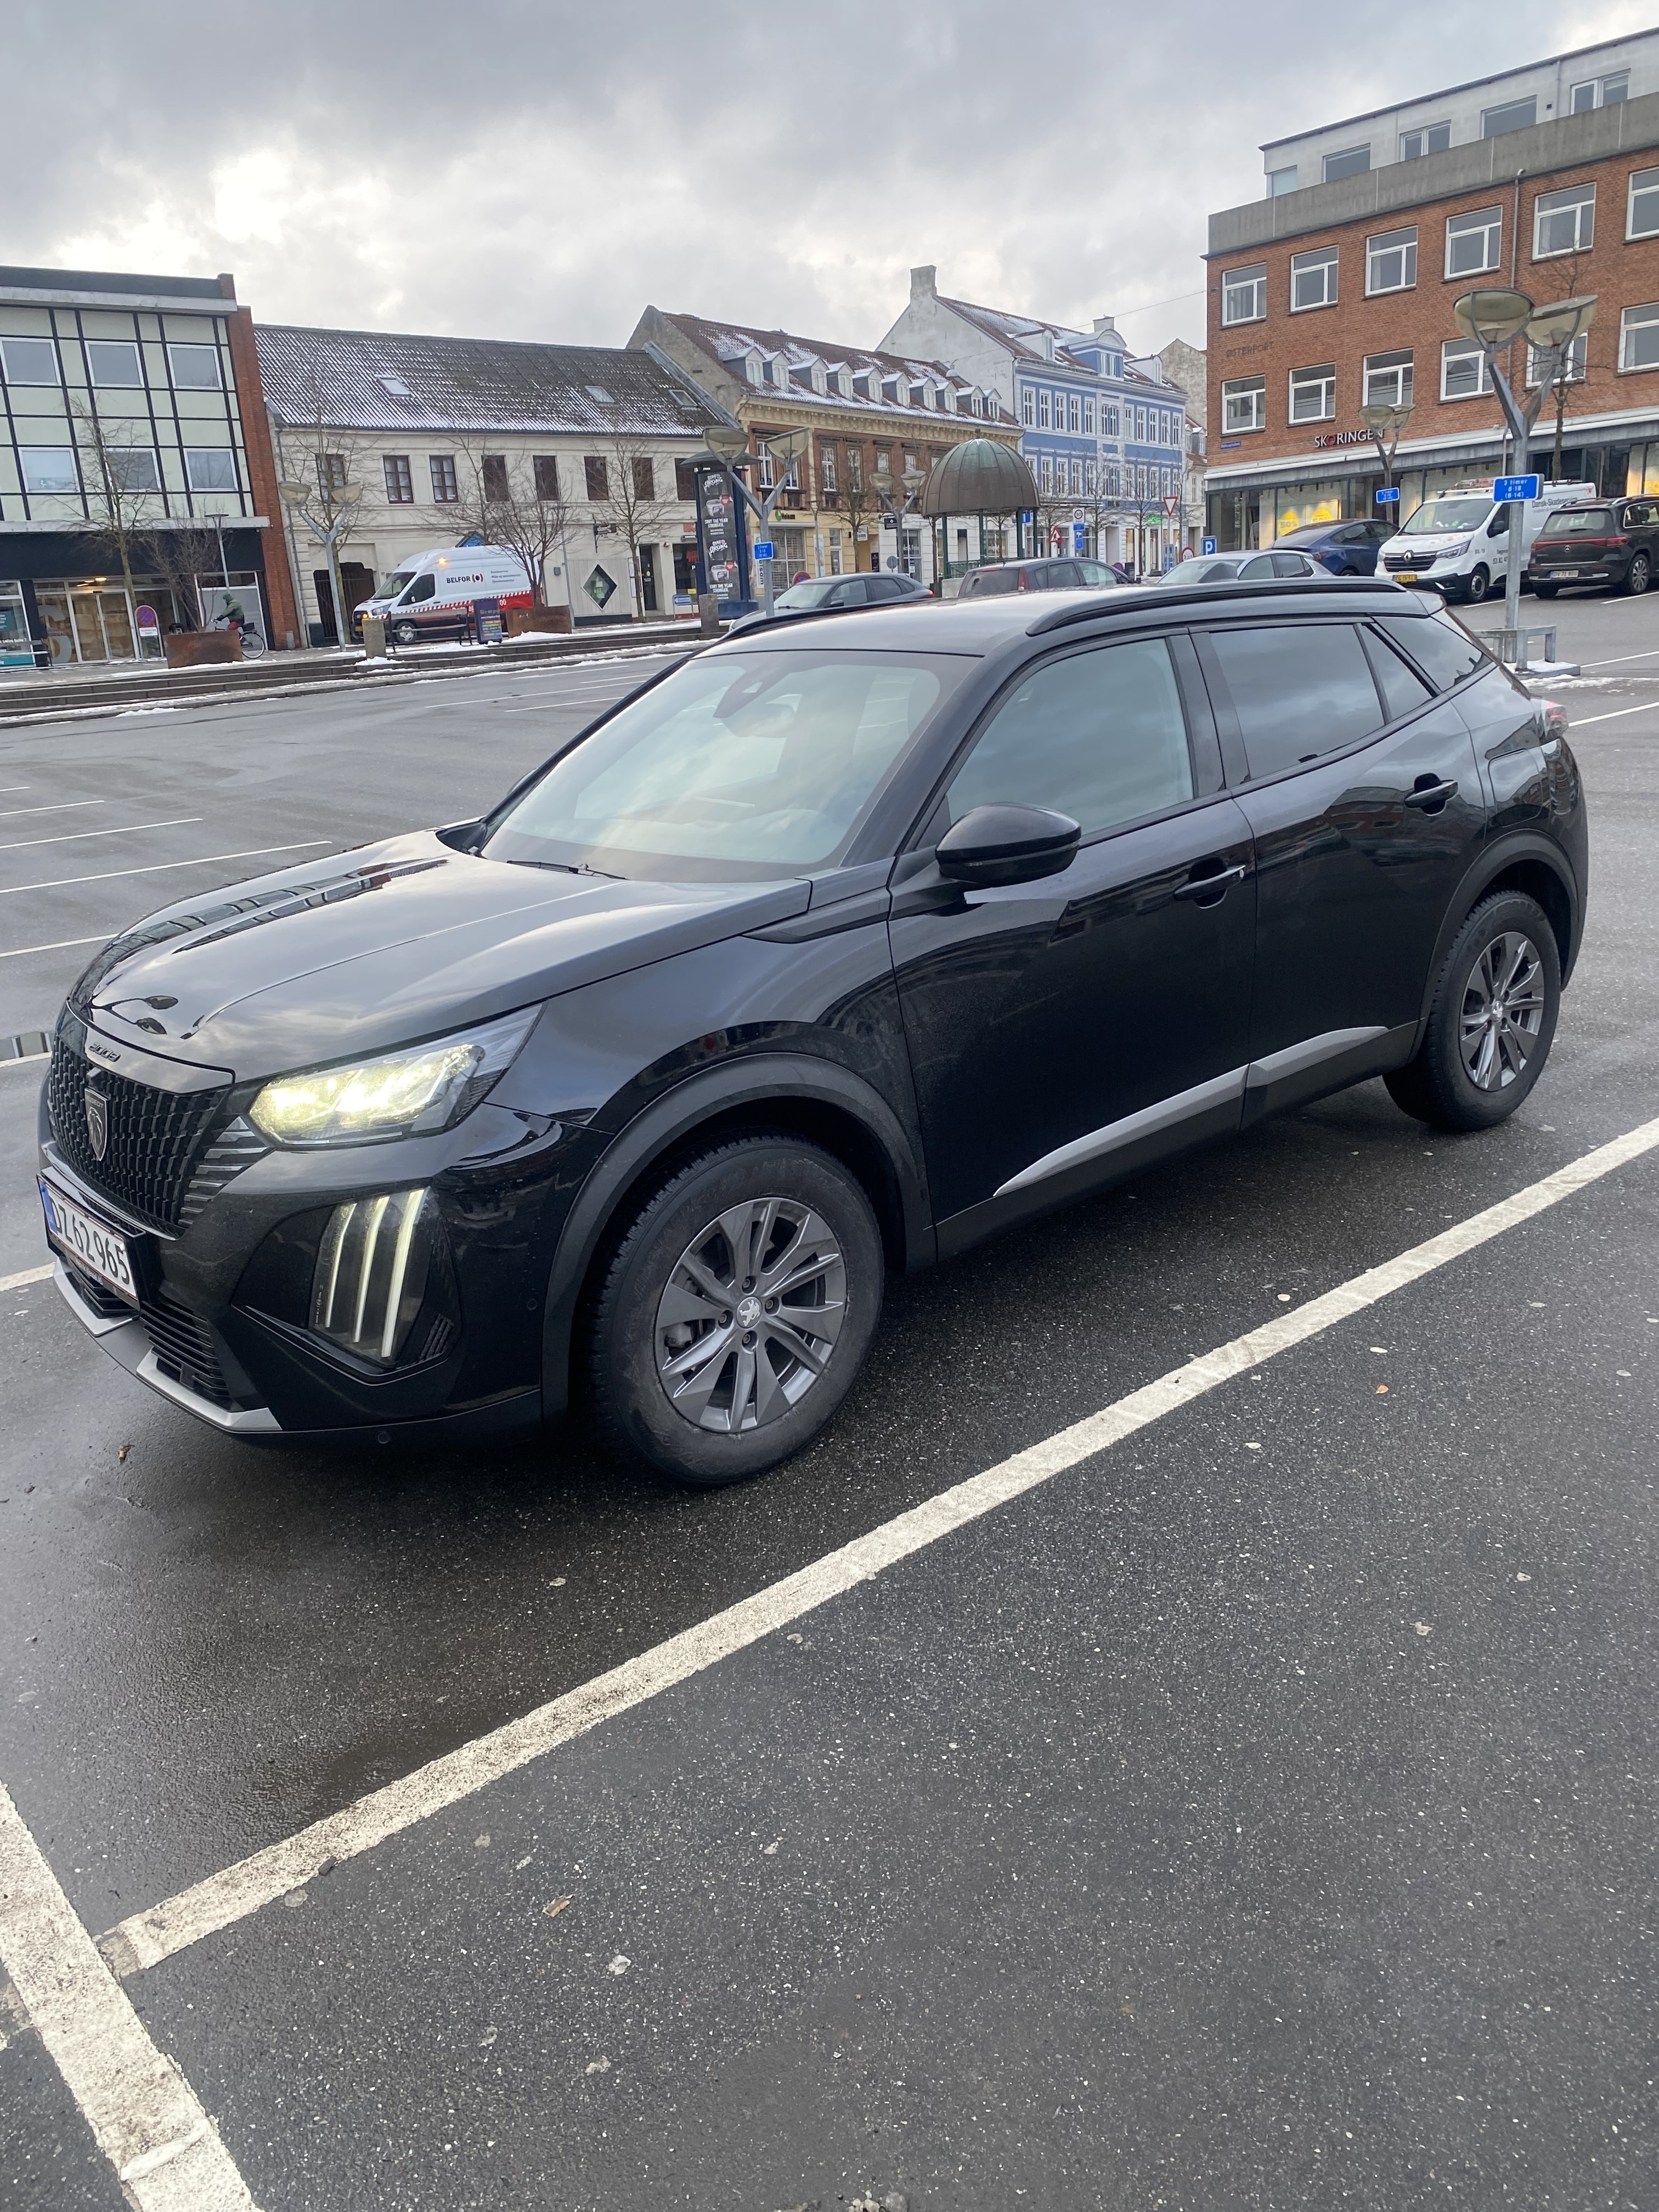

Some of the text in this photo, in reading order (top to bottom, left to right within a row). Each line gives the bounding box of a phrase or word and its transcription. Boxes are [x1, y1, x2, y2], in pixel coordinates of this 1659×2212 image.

[704, 477, 723, 488] STRONG
[709, 543, 728, 554] STRONG
[72, 1214, 95, 1262] 62
[93, 1231, 129, 1285] 965
